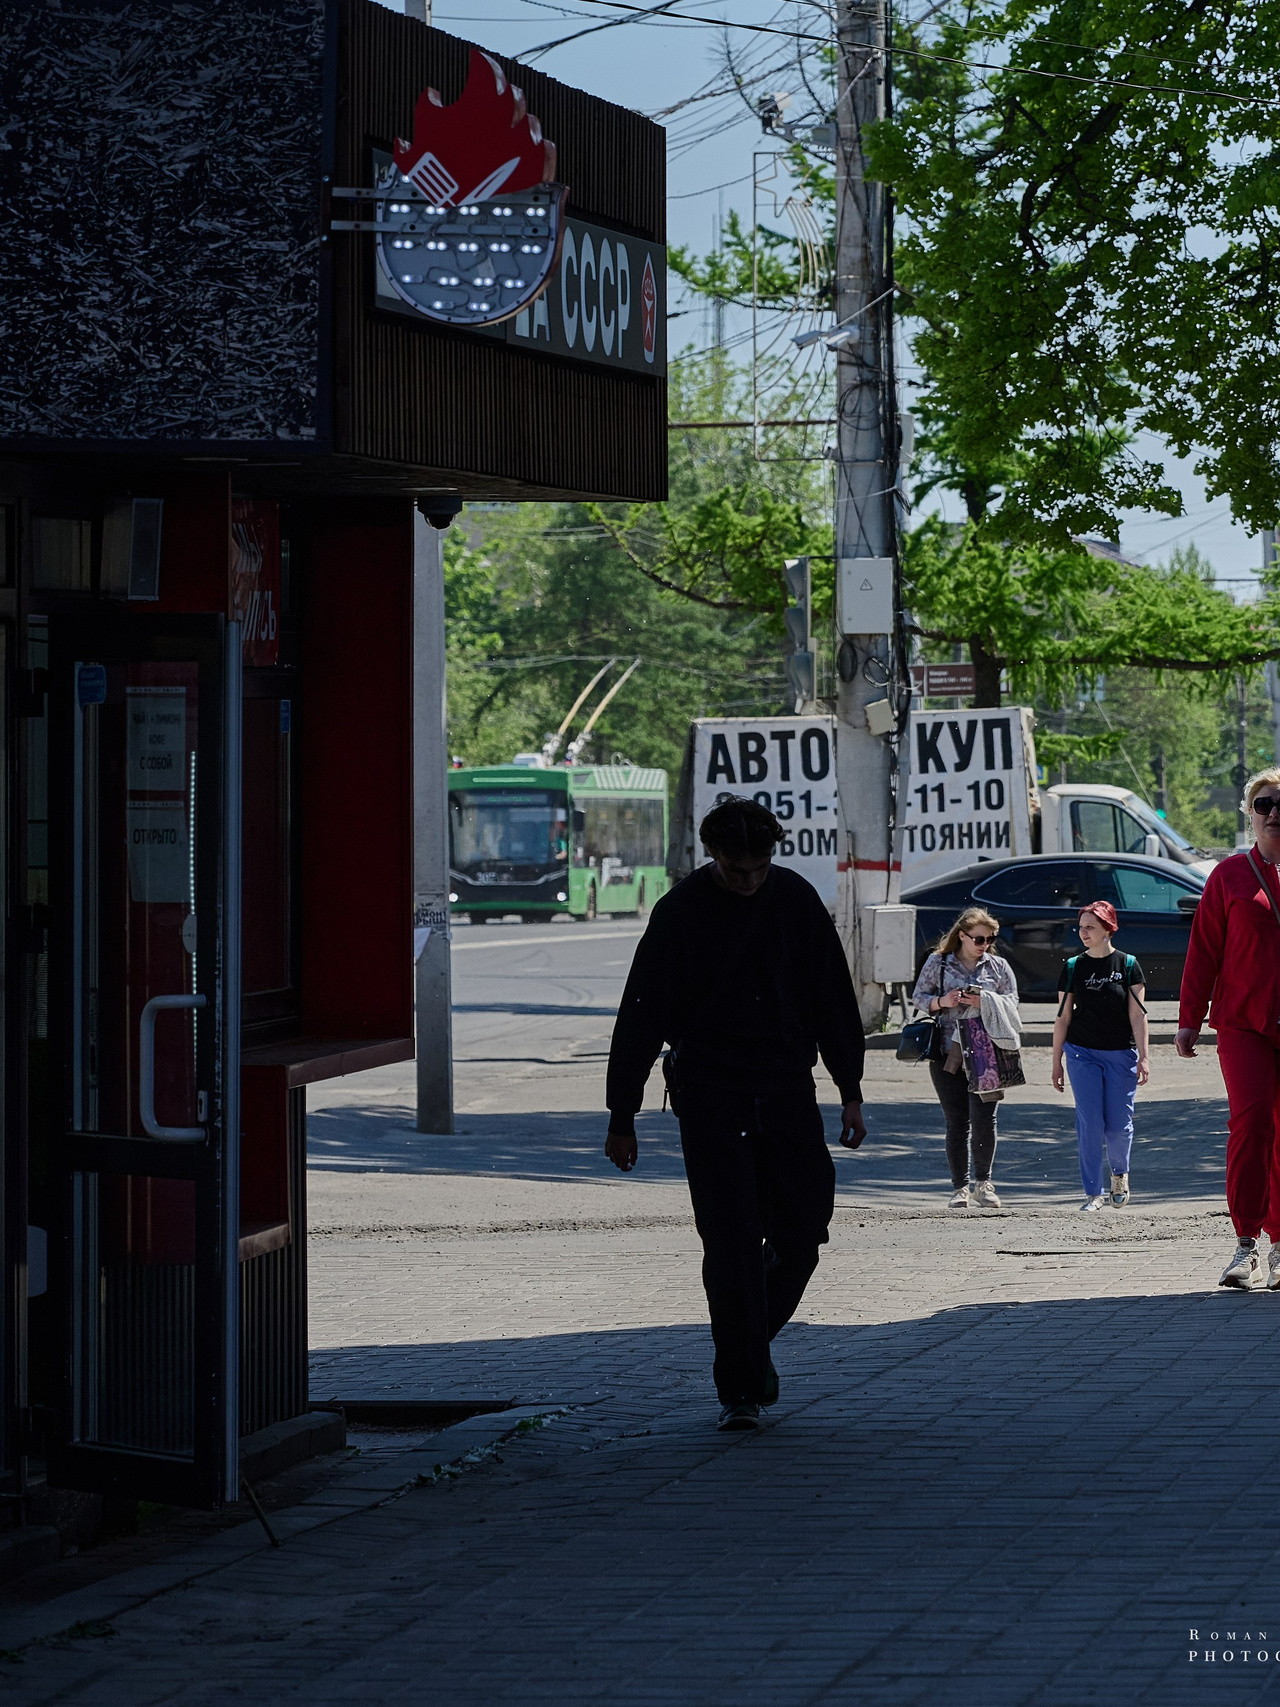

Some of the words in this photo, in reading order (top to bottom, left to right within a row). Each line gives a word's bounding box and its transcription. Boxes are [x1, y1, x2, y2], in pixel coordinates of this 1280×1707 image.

[560, 226, 630, 360] СССР
[146, 754, 172, 770] СОБОЙ
[133, 829, 177, 845] ОТКРЫТО
